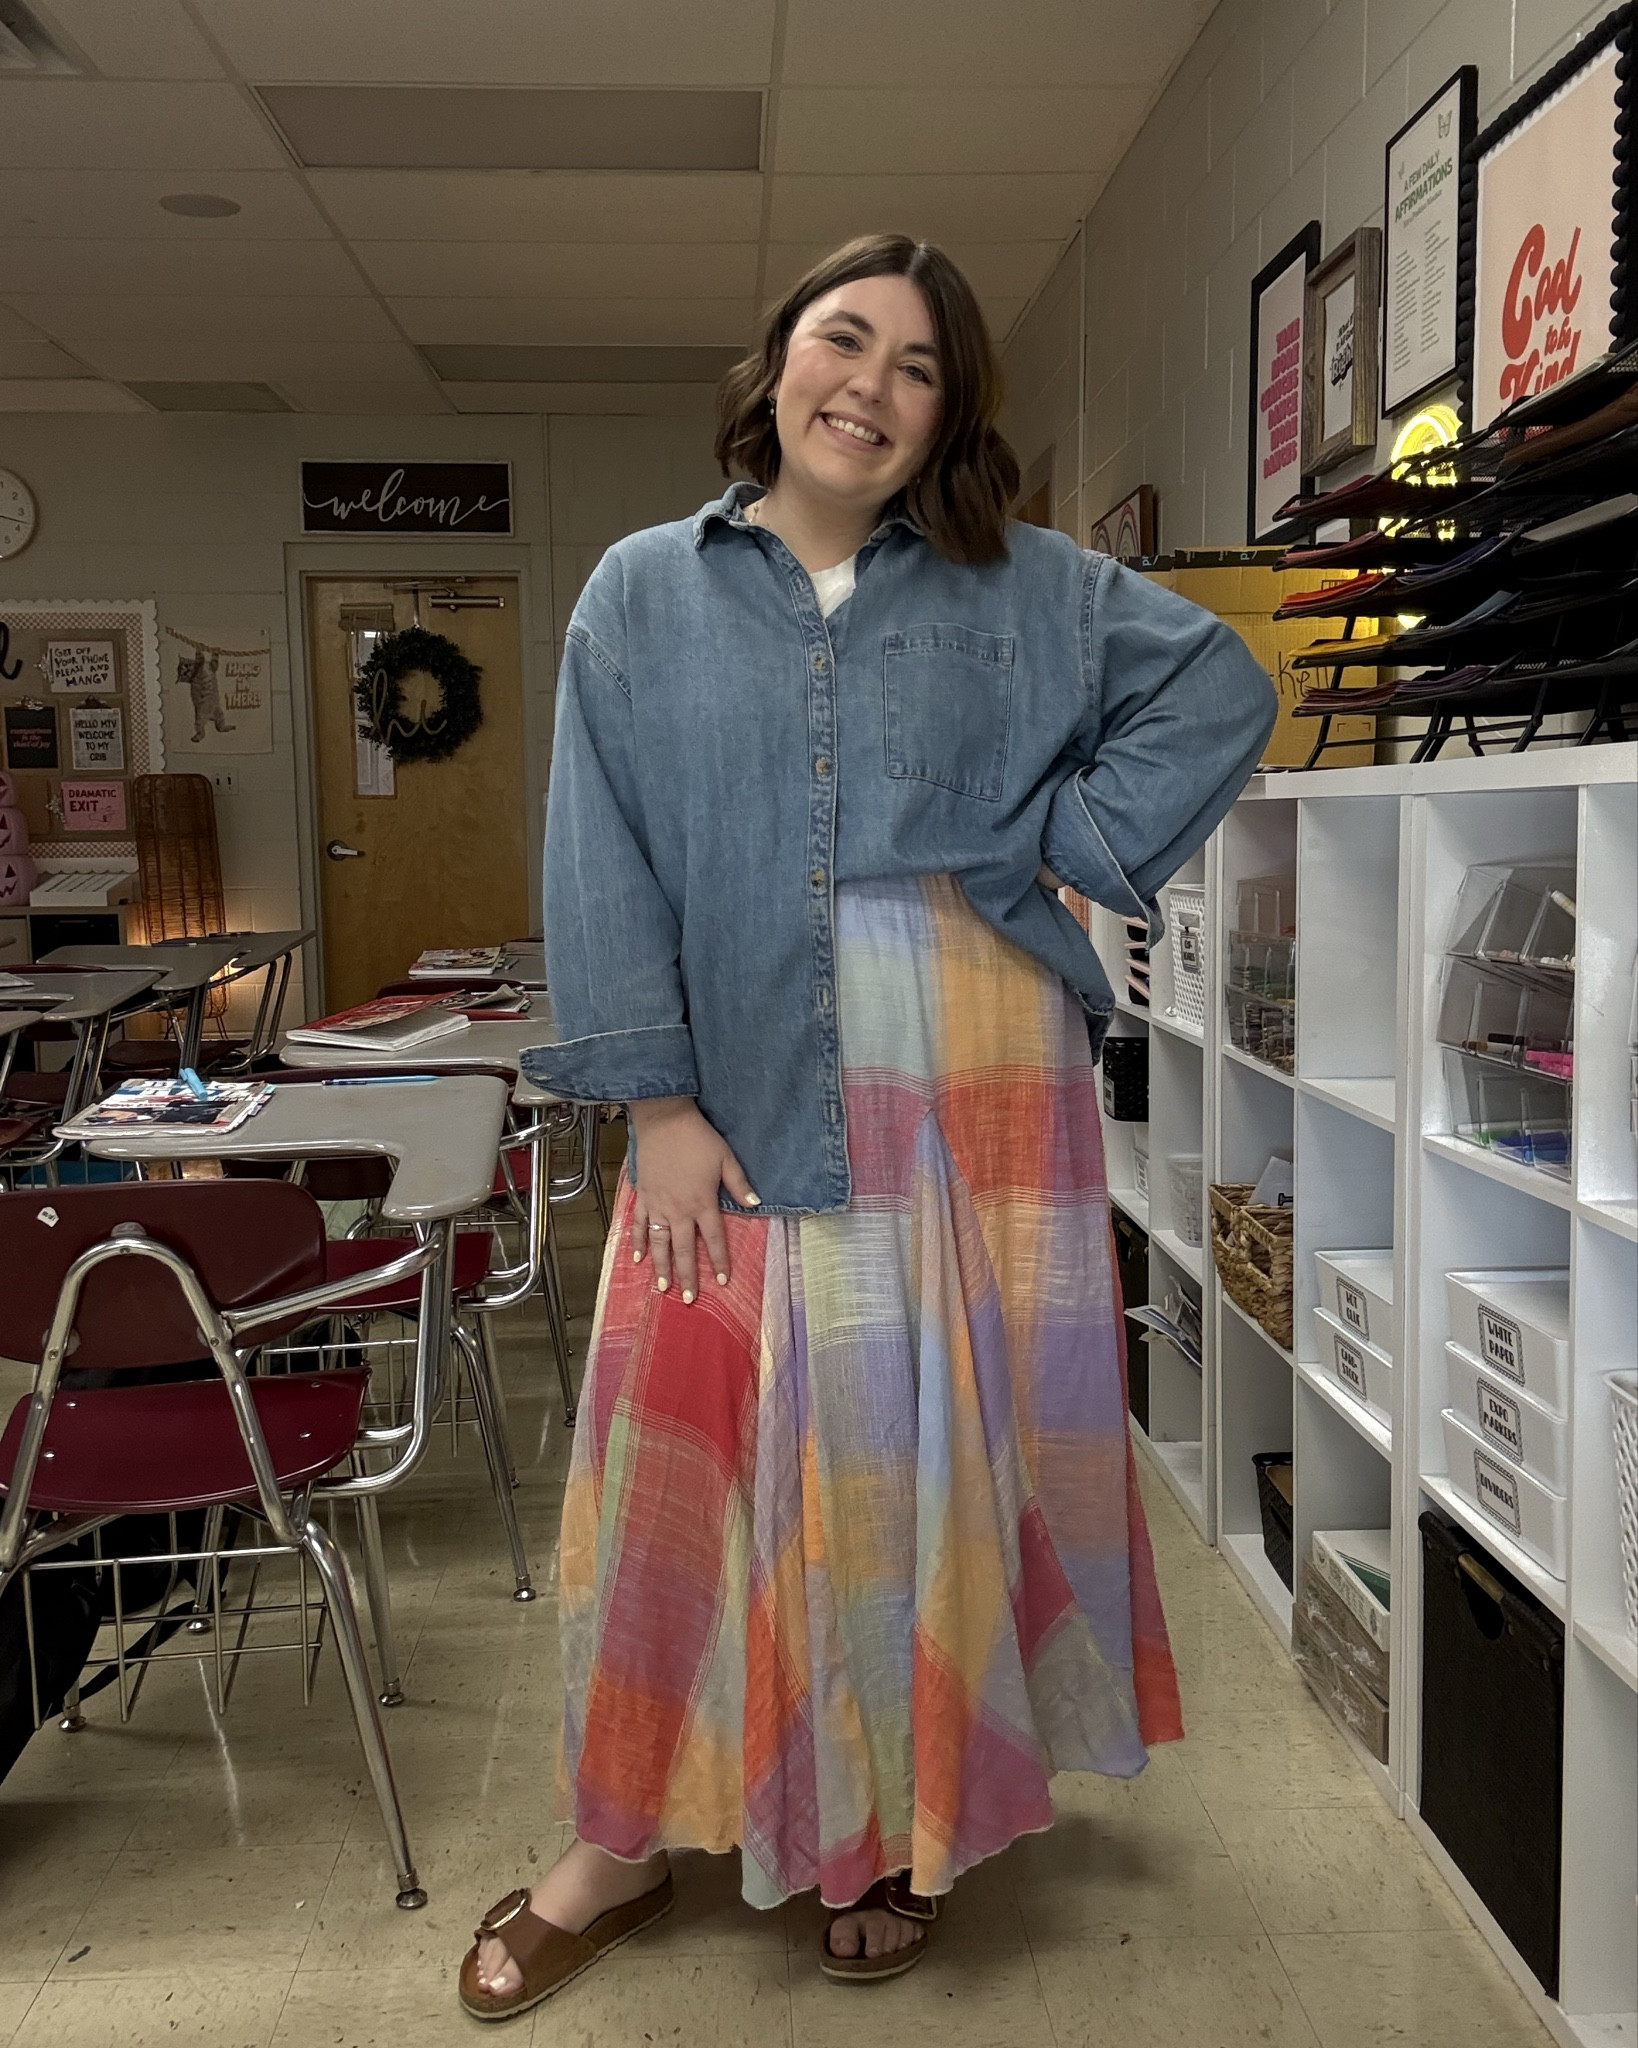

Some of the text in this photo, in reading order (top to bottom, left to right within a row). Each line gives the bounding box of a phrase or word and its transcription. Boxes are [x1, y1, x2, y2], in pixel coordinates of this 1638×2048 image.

[1395, 157, 1453, 223] AFFIRMATIONS
[1502, 223, 1582, 360] Cool
[1545, 316, 1572, 356] to be
[12, 491, 18, 500] 2
[303, 468, 511, 526] welcome
[18, 507, 25, 516] 3
[4, 535, 11, 544] 5
[55, 653, 109, 668] YOUR PHONE
[90, 664, 109, 673] AND
[369, 667, 447, 746] hi
[75, 719, 117, 728] HELLO MTV
[78, 731, 115, 739] WELCOME
[86, 742, 109, 750] TO MY
[68, 789, 117, 798] DRAMATIC
[70, 800, 99, 812] EXIT
[1487, 1319, 1513, 1347] WHITE
[1489, 1339, 1515, 1367] PAPER
[1342, 1362, 1360, 1385] STOCK
[1489, 1399, 1509, 1422] EXPO
[1483, 1411, 1517, 1446] MARKERS
[1480, 1472, 1514, 1509] DIVIDERS
